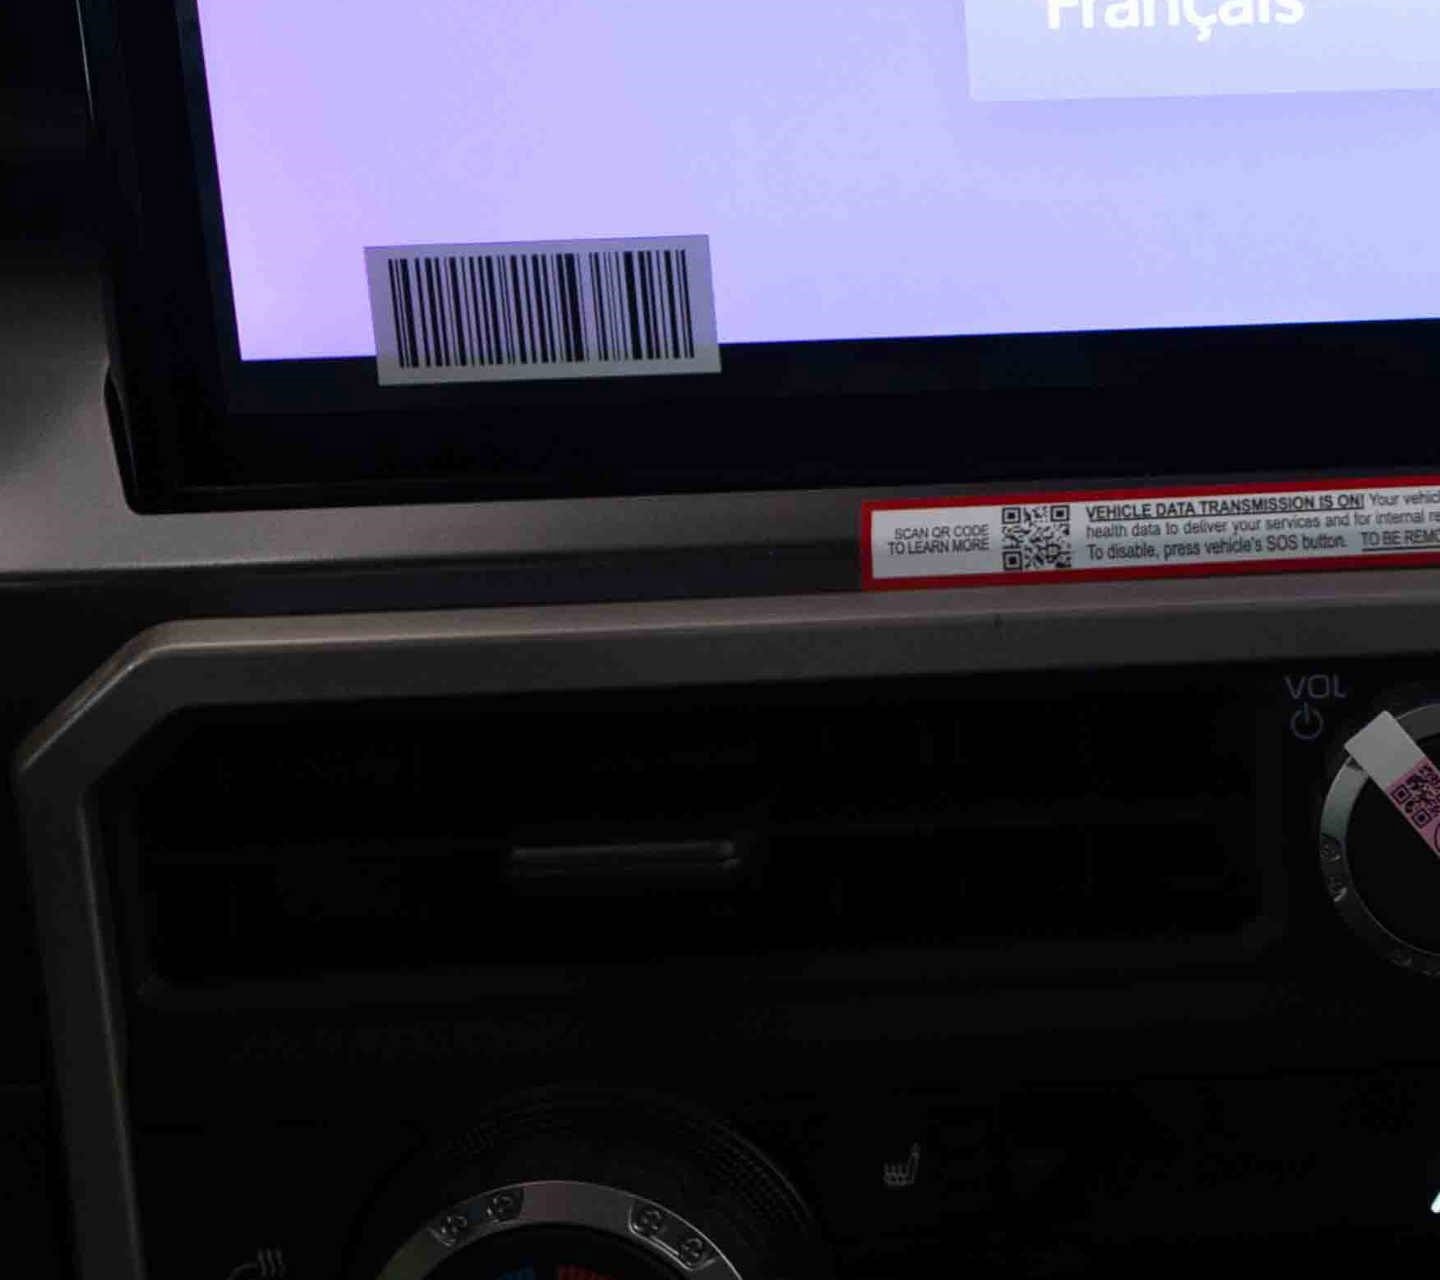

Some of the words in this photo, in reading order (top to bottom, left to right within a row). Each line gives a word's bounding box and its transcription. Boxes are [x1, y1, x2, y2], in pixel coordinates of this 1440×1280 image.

[1086, 503, 1152, 520] VEHICLE
[1156, 501, 1195, 517] DATA
[1200, 496, 1315, 515] TRANSMISSION
[1319, 494, 1333, 508] IS
[1369, 492, 1399, 506] Your
[894, 527, 929, 541] SCAN
[955, 524, 990, 538] CODE
[1086, 523, 1128, 539] health
[1131, 521, 1161, 537] data
[1166, 521, 1178, 536] to
[1183, 520, 1228, 535] deliver
[1233, 520, 1261, 537] your
[1265, 516, 1320, 531] services
[1325, 513, 1350, 527] and
[1353, 512, 1372, 526] for
[1375, 510, 1425, 524] internal
[888, 542, 905, 556] TO
[907, 539, 949, 555] LEARN
[951, 537, 990, 552] MORE
[1086, 543, 1103, 560] To
[1107, 542, 1158, 560] disable,
[1163, 542, 1201, 561] press
[1205, 536, 1261, 554] vehicle's
[1266, 534, 1298, 552] SOS
[1302, 533, 1347, 550] button.
[1361, 530, 1380, 547] TO
[1382, 529, 1402, 545] BE
[1284, 672, 1348, 700] VOL
